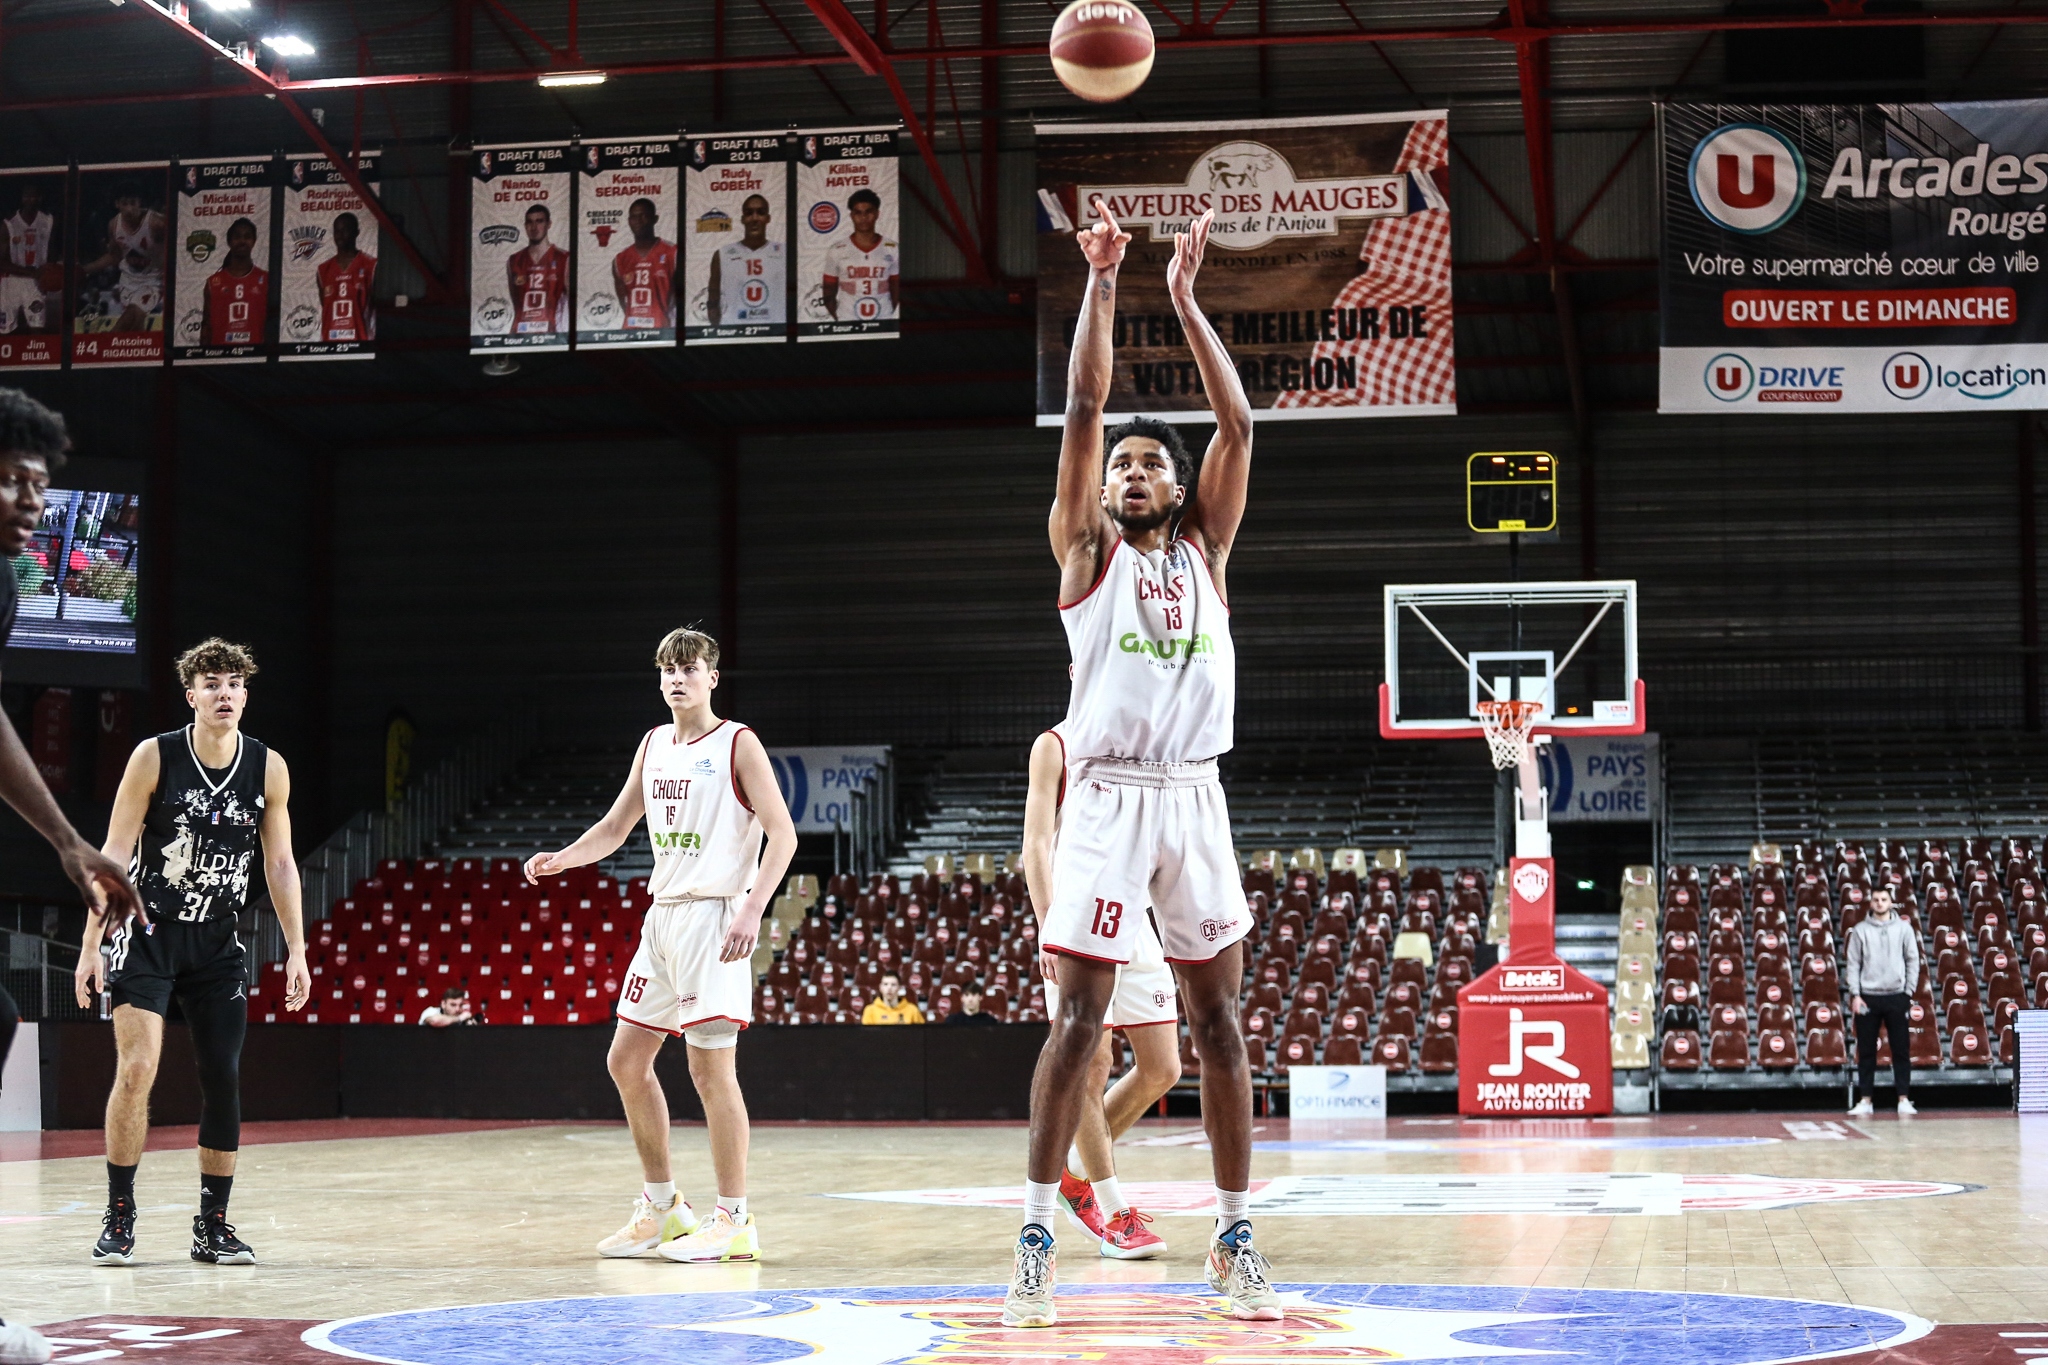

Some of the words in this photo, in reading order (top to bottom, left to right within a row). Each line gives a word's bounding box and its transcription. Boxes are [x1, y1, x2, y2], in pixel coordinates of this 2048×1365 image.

[712, 139, 750, 150] DRAFT
[752, 138, 779, 149] NBA
[823, 135, 862, 146] DRAFT
[863, 133, 890, 144] NBA
[498, 150, 536, 162] DRAFT
[537, 149, 564, 160] NBA
[604, 144, 642, 156] DRAFT
[645, 143, 671, 154] NBA
[729, 150, 761, 162] 2013
[840, 146, 872, 157] 2020
[358, 159, 374, 170] BA
[514, 162, 546, 172] 2009
[622, 156, 654, 167] 2010
[203, 166, 239, 176] DRAFT
[240, 164, 265, 174] NBA
[721, 168, 752, 180] Rudy
[829, 164, 867, 175] Killian
[1821, 142, 2048, 199] Arcades
[218, 176, 248, 187] 2005
[502, 178, 542, 190] Nando
[612, 174, 645, 184] Kevin
[826, 176, 870, 187] HAYES
[595, 184, 662, 198] SERAPHIN
[710, 180, 763, 192] GOBERT
[202, 192, 246, 204] Mickael
[494, 192, 511, 202] DE
[514, 190, 550, 202] COLO
[1220, 194, 1262, 214] DES
[1270, 182, 1398, 214] MAUGES
[193, 204, 255, 217] GELABALE
[300, 200, 362, 212] BEAUBOIS
[1241, 216, 1261, 232] de
[1266, 213, 1327, 234] l'Anjou
[1947, 204, 2047, 241] Rougé
[746, 260, 762, 276] 15
[1683, 252, 1746, 276] Votre
[1752, 252, 1893, 282] supermarché
[1900, 256, 1961, 276] cœur
[1968, 251, 1996, 274] de
[2003, 250, 2040, 273] ville
[634, 270, 650, 286] 13
[847, 266, 885, 280] CHOLET
[529, 273, 545, 290] 12
[862, 281, 871, 295] 3
[234, 284, 244, 300] 6
[338, 282, 348, 298] 8
[1730, 299, 1835, 322] OUVERT
[1842, 300, 1870, 321] LE
[1877, 298, 2010, 322] DIMANCHE
[1232, 308, 1380, 344] MEILLEUR
[1388, 306, 1428, 339] DE
[26, 340, 46, 350] Jim
[76, 340, 98, 356] #4
[111, 336, 153, 347] Antoine
[21, 351, 50, 360] BILBA
[102, 347, 160, 358] RIGAUDEAU
[1758, 367, 1846, 388] DRIVE
[1936, 363, 2047, 388] location
[1762, 391, 1839, 402] coursesu.com
[1162, 606, 1183, 631] 13
[1587, 754, 1646, 777] PAYS
[652, 779, 692, 800] CHOLET
[1580, 791, 1646, 812] LOIRE
[666, 806, 676, 826] 15
[178, 892, 213, 922] 31
[1090, 898, 1124, 939] 13
[1202, 924, 1217, 937] CB
[624, 972, 648, 1004] 15
[1468, 992, 1594, 1004] www.jeanrouyerautomobiles.fr
[1476, 1083, 1520, 1102] JEAN
[1523, 1083, 1592, 1100] ROUYER
[1484, 1098, 1586, 1111] AUTOMOBILES
